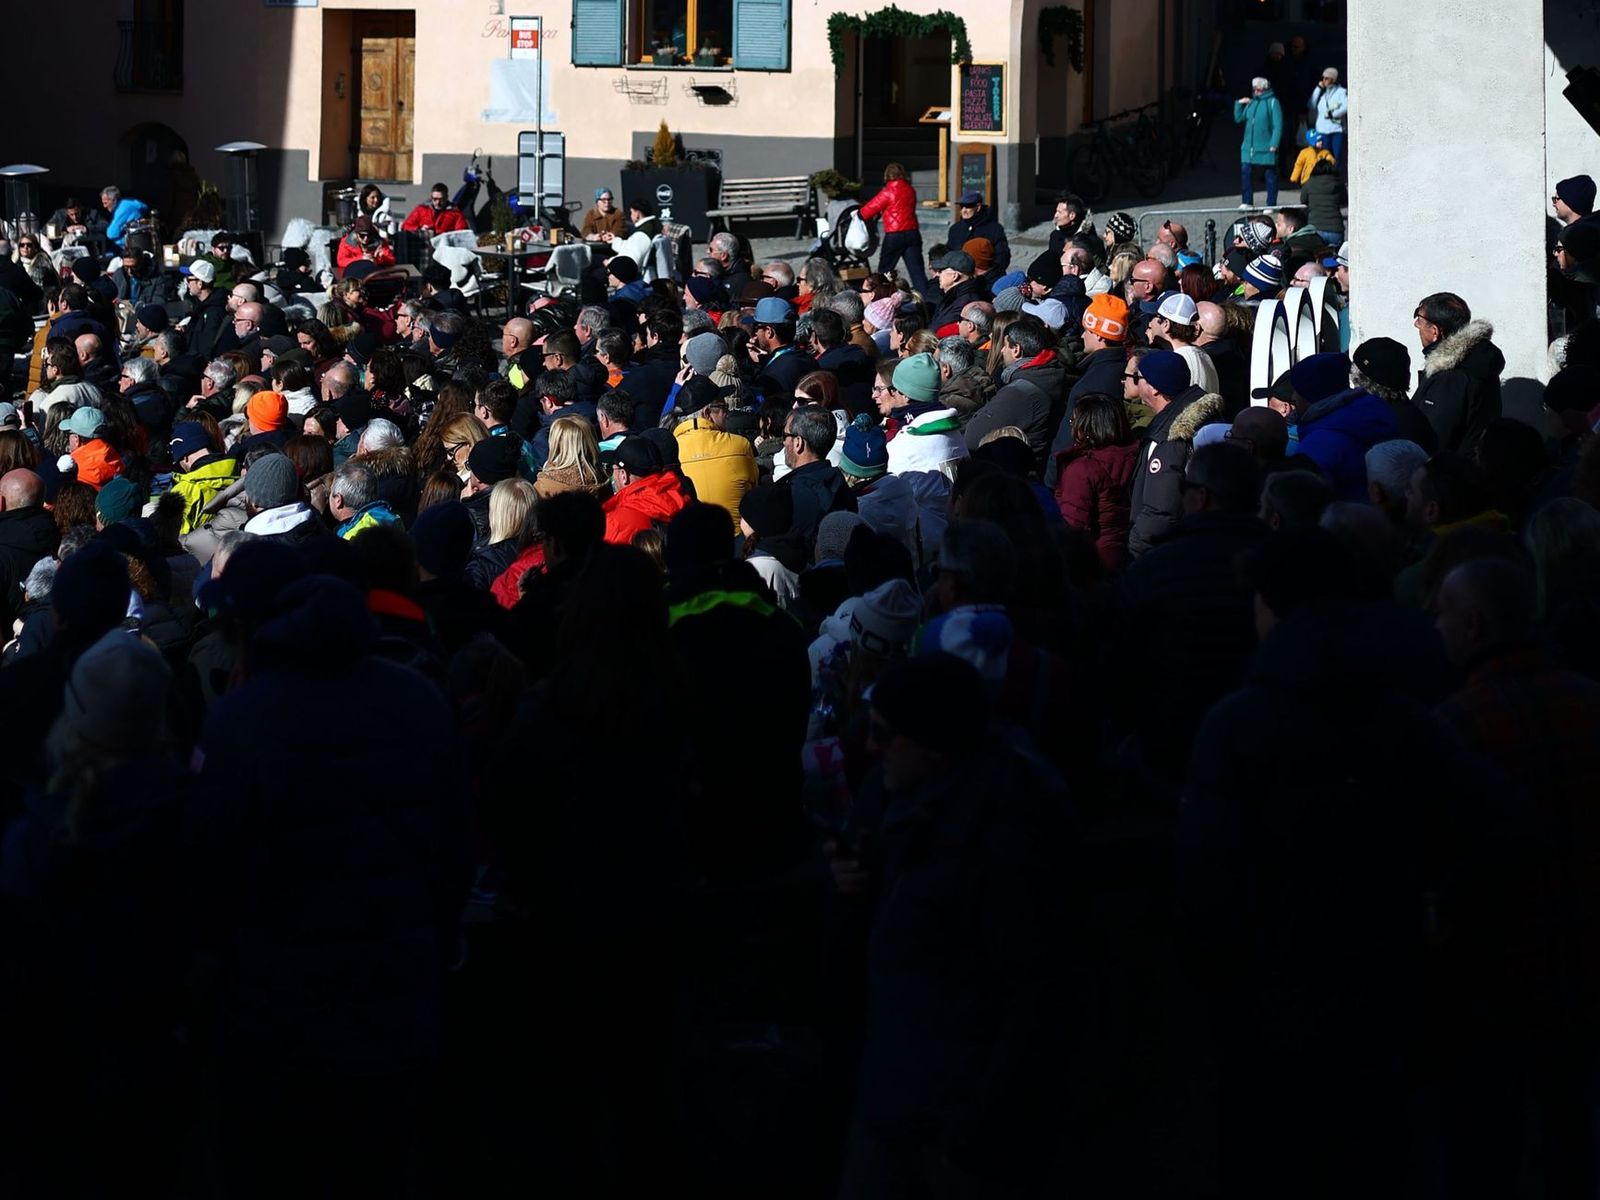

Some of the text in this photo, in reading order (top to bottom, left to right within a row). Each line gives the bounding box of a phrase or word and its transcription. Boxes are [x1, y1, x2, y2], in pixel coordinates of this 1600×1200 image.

[519, 31, 532, 39] BUS
[516, 40, 534, 48] STOP
[965, 89, 986, 97] PASTA
